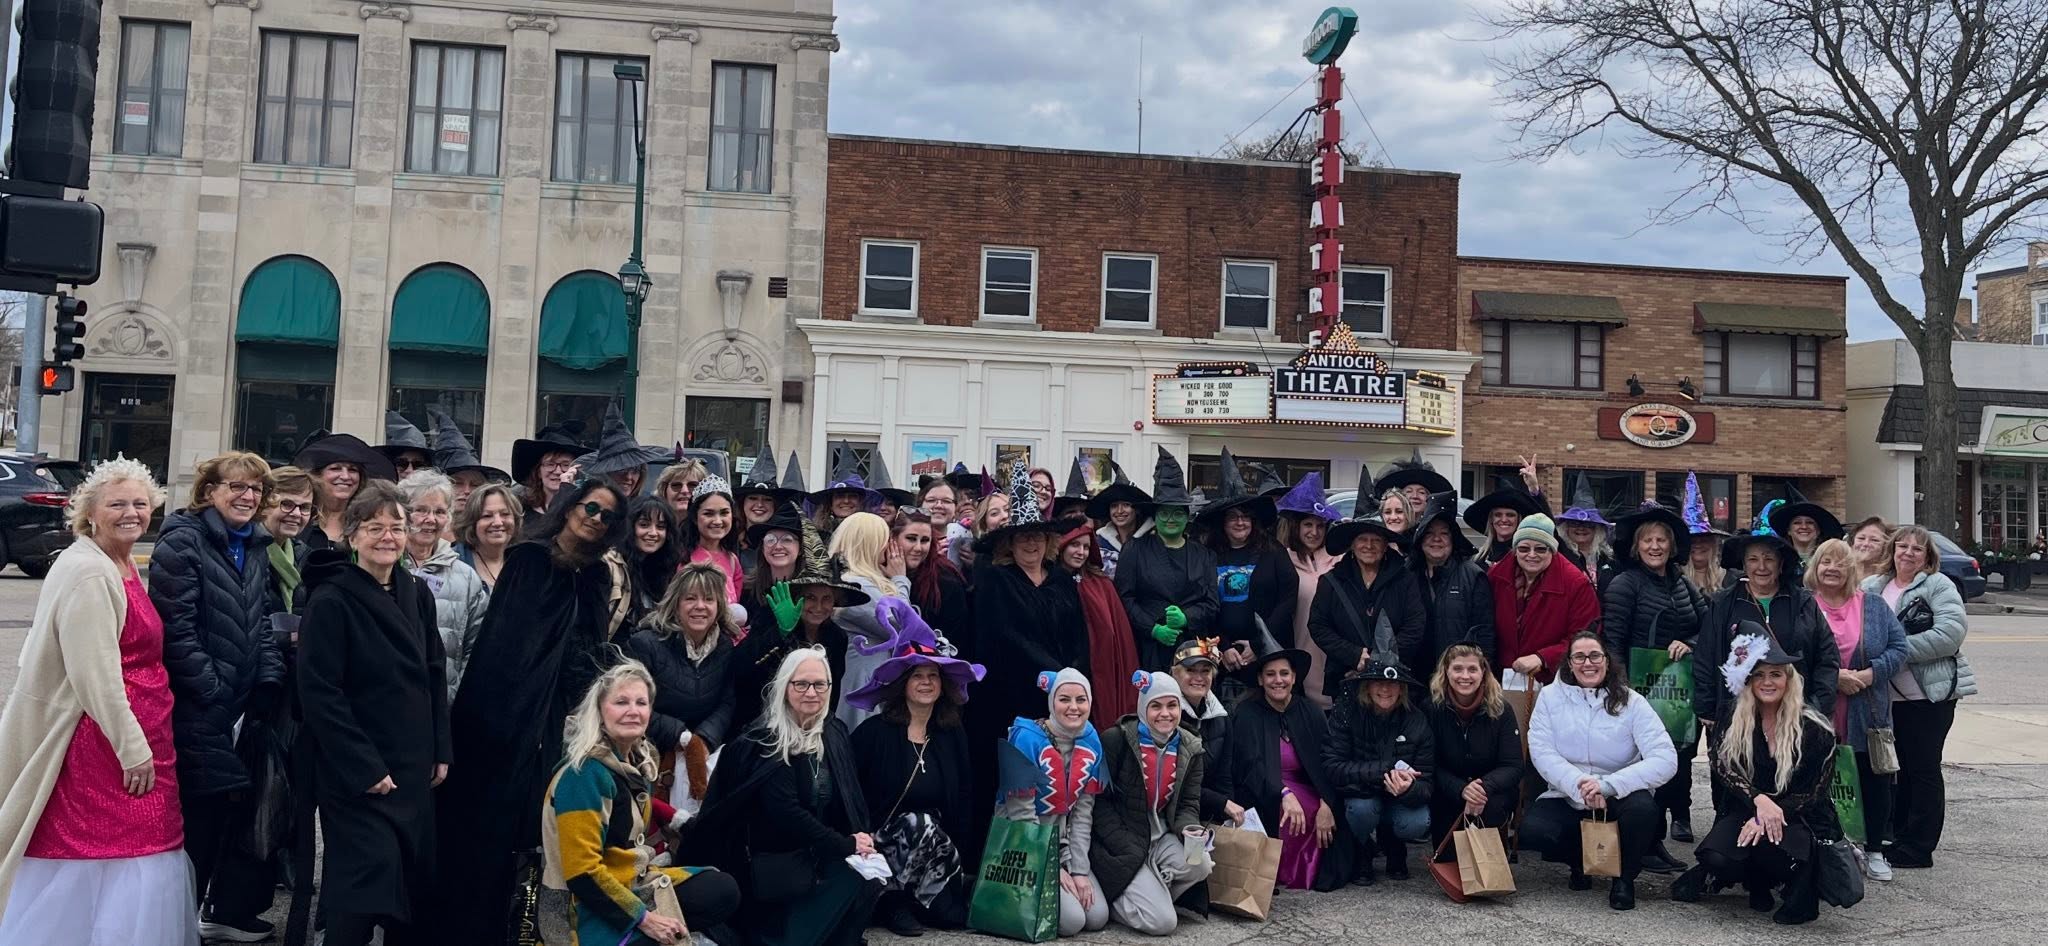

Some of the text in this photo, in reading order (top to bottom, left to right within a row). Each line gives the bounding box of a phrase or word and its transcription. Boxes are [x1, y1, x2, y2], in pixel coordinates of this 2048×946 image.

[1307, 354, 1374, 369] ANTIOCH
[1180, 382, 1233, 390] WICKED FOR GOOD
[1284, 371, 1396, 396] THEATRE
[1646, 673, 1677, 687] DEFY
[1001, 850, 1027, 868] DEFY
[985, 864, 1037, 888] GRAVITY
